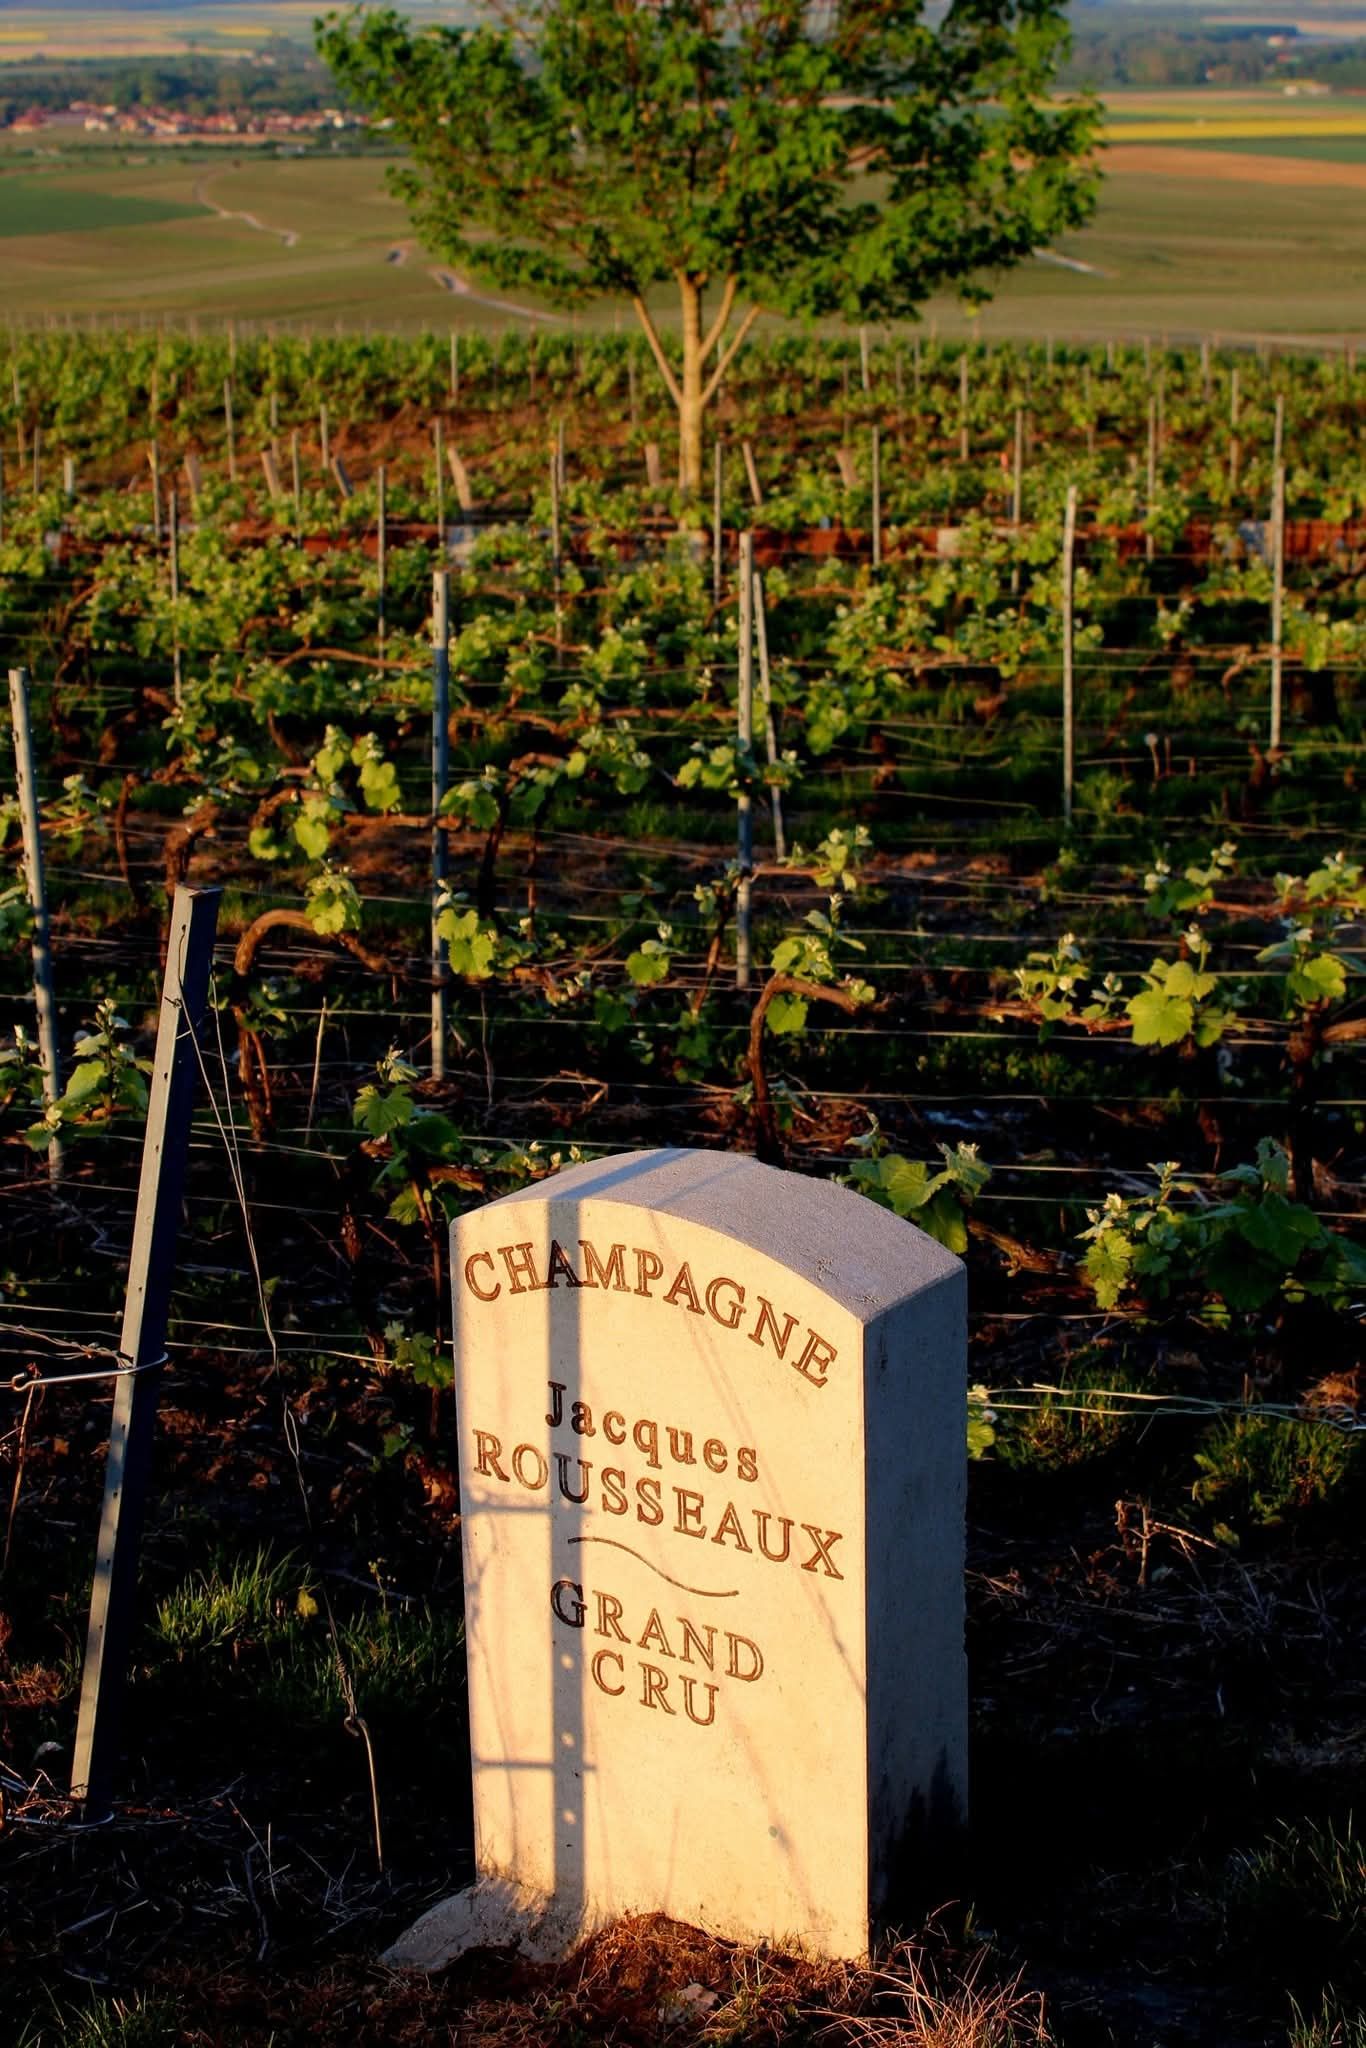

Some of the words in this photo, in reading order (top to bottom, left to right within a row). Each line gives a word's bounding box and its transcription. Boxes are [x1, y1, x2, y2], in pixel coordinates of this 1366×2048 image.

[464, 1239, 838, 1388] CHAMPAGNE
[545, 1381, 759, 1482] Jacques
[472, 1429, 845, 1580] ROUSSEAUX
[550, 1579, 765, 1682] GRAND
[591, 1649, 720, 1726] CRU
